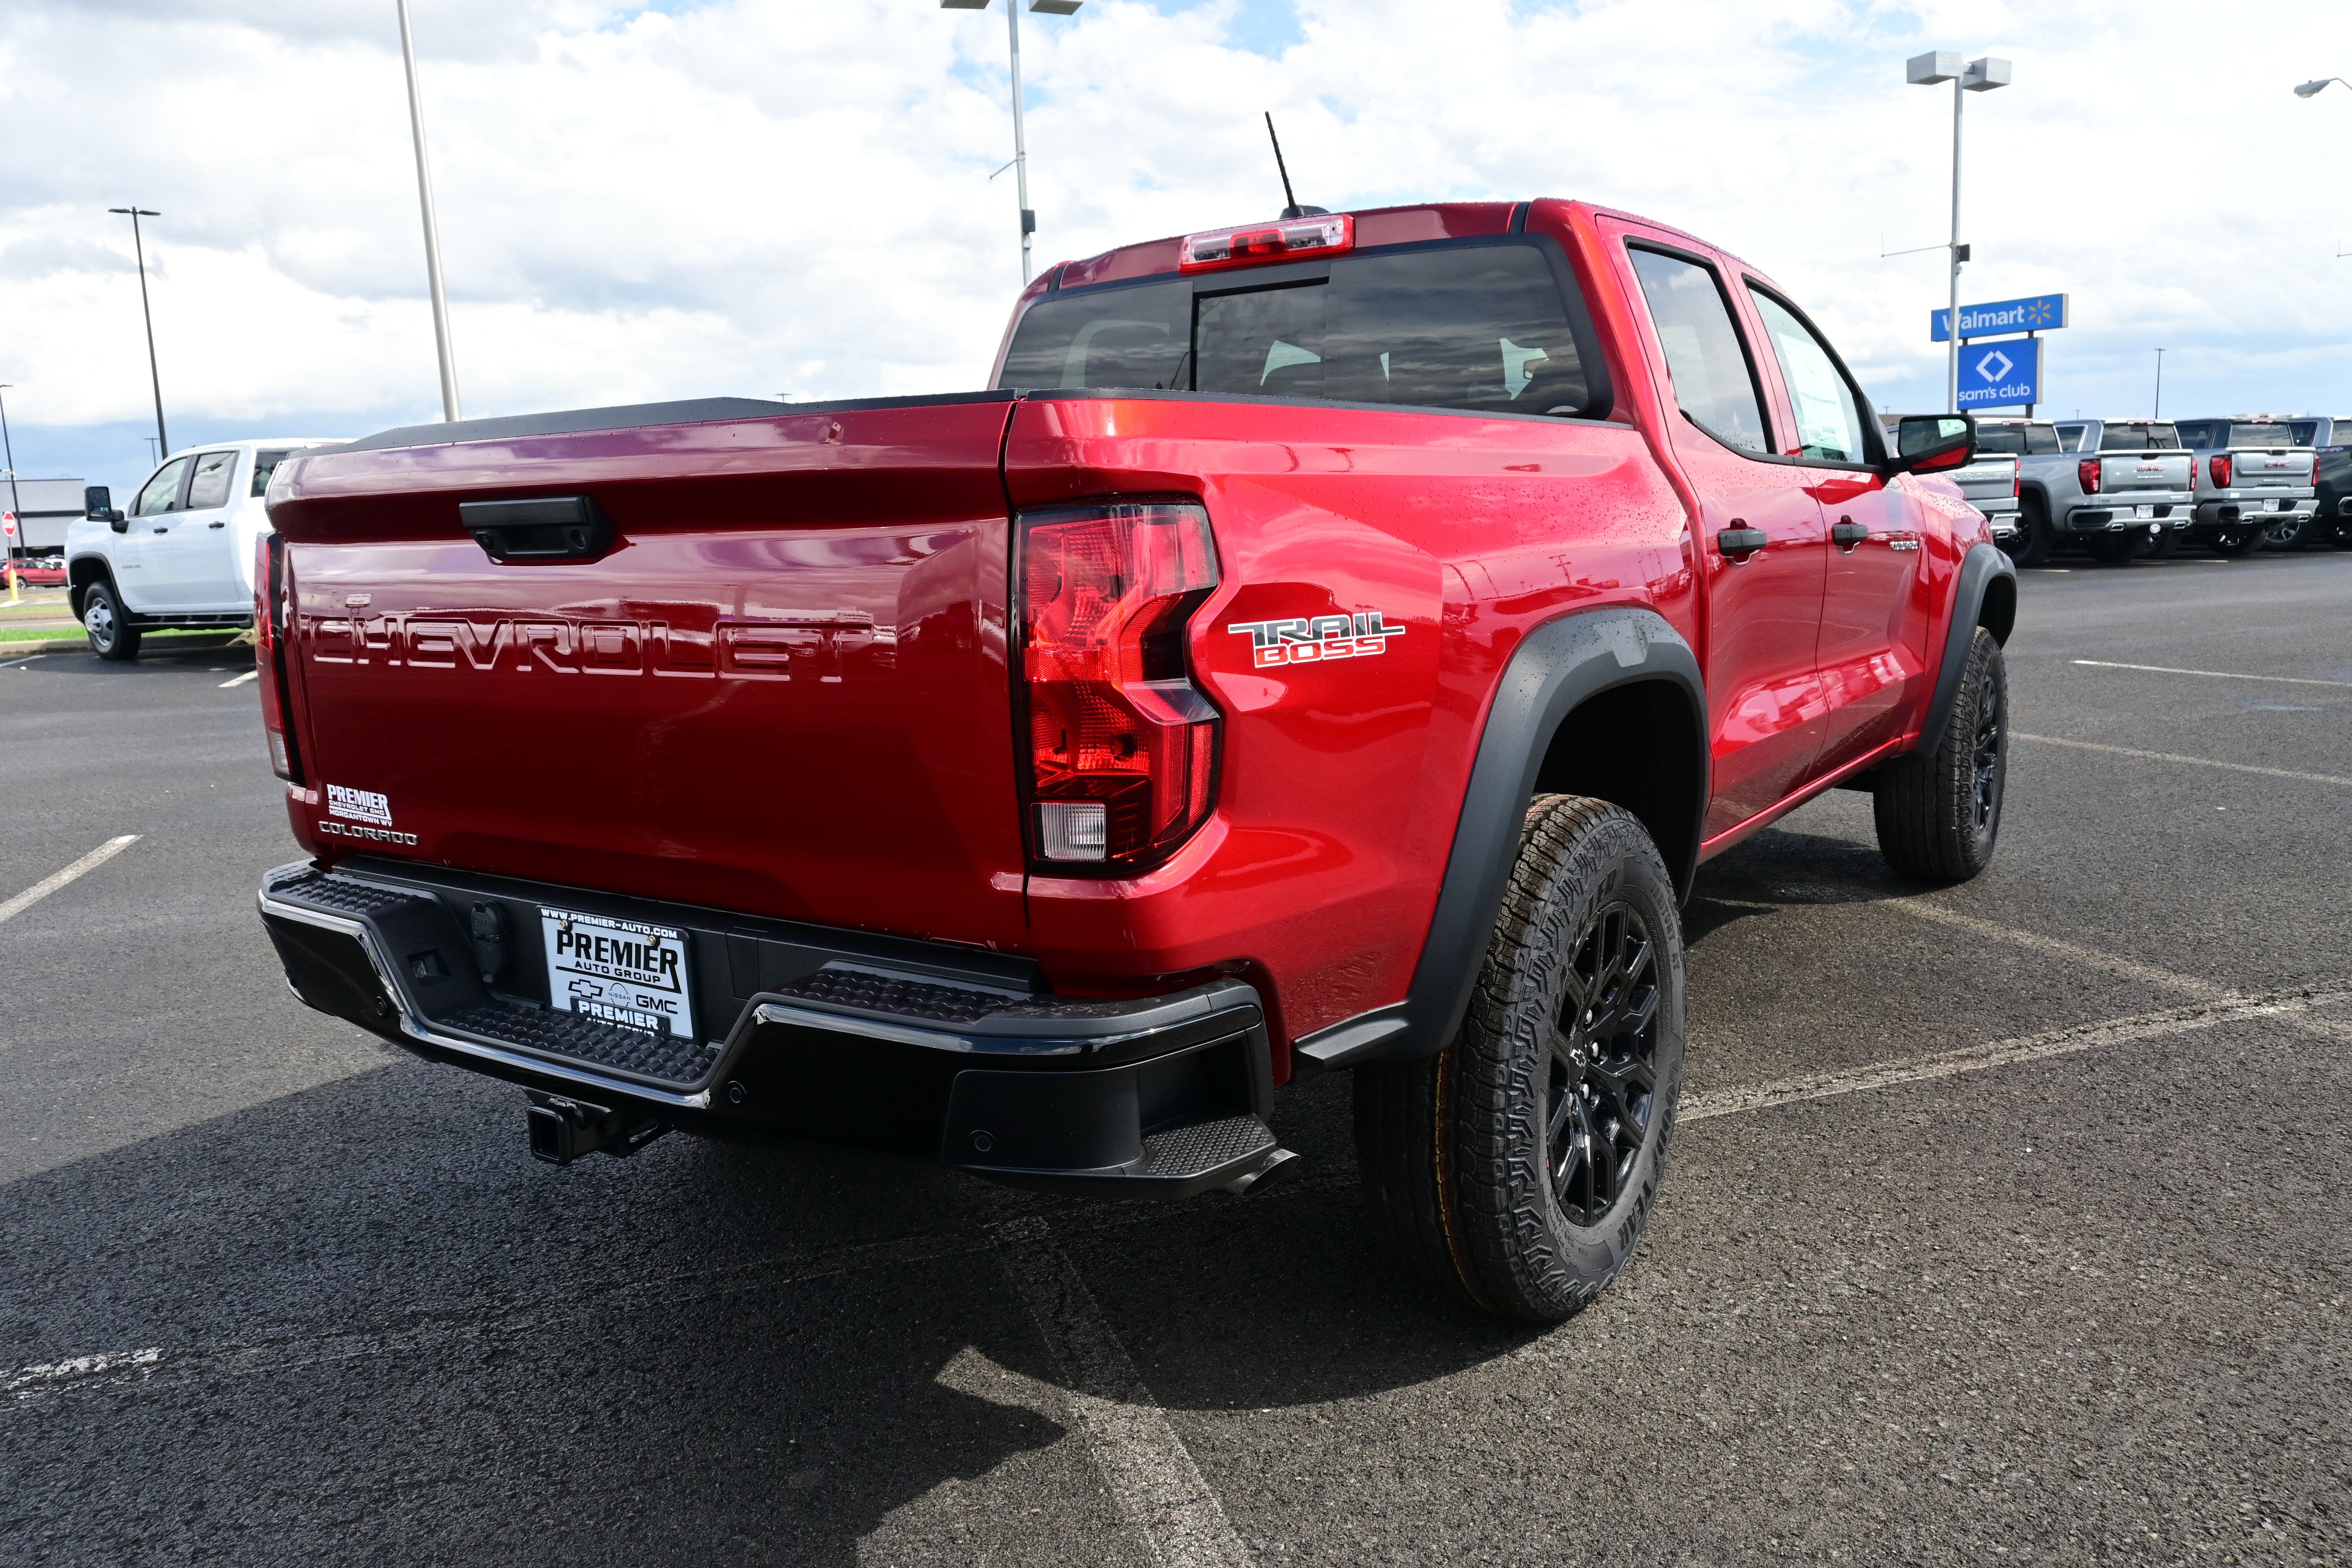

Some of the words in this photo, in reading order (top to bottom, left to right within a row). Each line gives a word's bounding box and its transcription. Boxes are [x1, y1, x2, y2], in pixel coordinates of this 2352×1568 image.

[1959, 386, 1997, 401] sam's
[1999, 383, 2030, 398] club
[1228, 611, 1406, 646] TRAIL
[310, 615, 874, 683] CHEVROLET
[1254, 635, 1386, 668] BOSS
[327, 784, 389, 812] PREMIER
[329, 800, 368, 812] CHEVROLET
[369, 808, 385, 816] GMC
[329, 808, 380, 825] MORGANTOWN
[380, 819, 392, 827] WV
[318, 821, 418, 845] COLORADO
[540, 908, 677, 939] WWW.PREMIER-AUTO.COM
[556, 929, 678, 976] PREMIER
[574, 960, 610, 974] AUTO
[615, 968, 661, 983] GROUP
[608, 991, 631, 1001] NISSAN
[636, 994, 678, 1015] GMC
[578, 1000, 659, 1030] PREMIER
